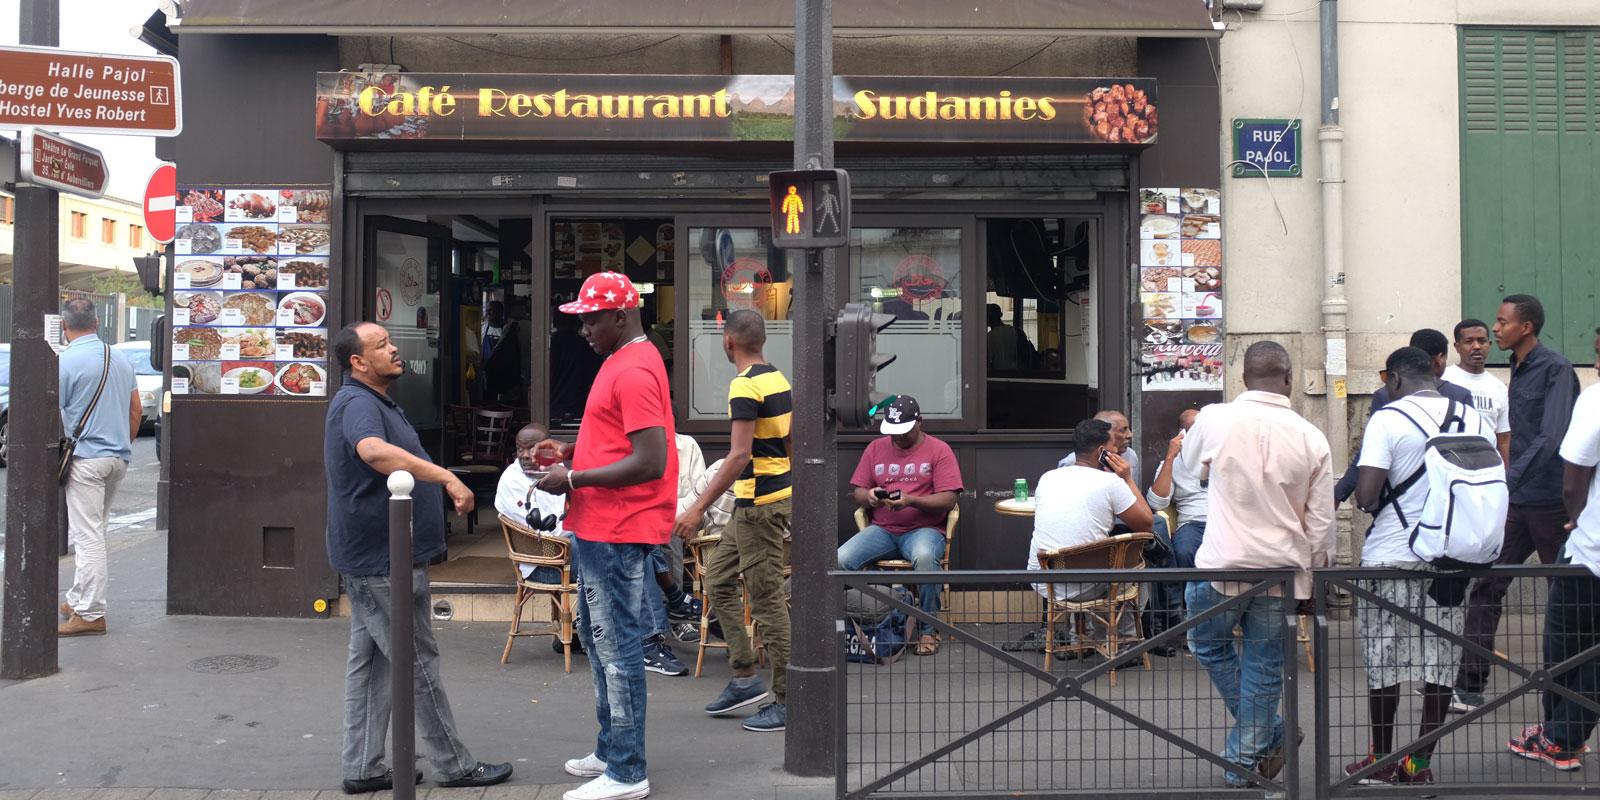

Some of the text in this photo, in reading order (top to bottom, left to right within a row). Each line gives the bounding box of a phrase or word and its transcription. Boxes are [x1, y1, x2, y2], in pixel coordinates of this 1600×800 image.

[48, 62, 146, 84] Halle Pajol
[50, 83, 69, 98] de
[74, 84, 146, 102] Jeunesse
[0, 101, 146, 121] Hostel Yves Robert
[358, 84, 1057, 121] Café Restaurant Sudanies
[1253, 130, 1282, 142] RUE
[61, 146, 67, 157] Le
[1246, 151, 1291, 163] PAJOL
